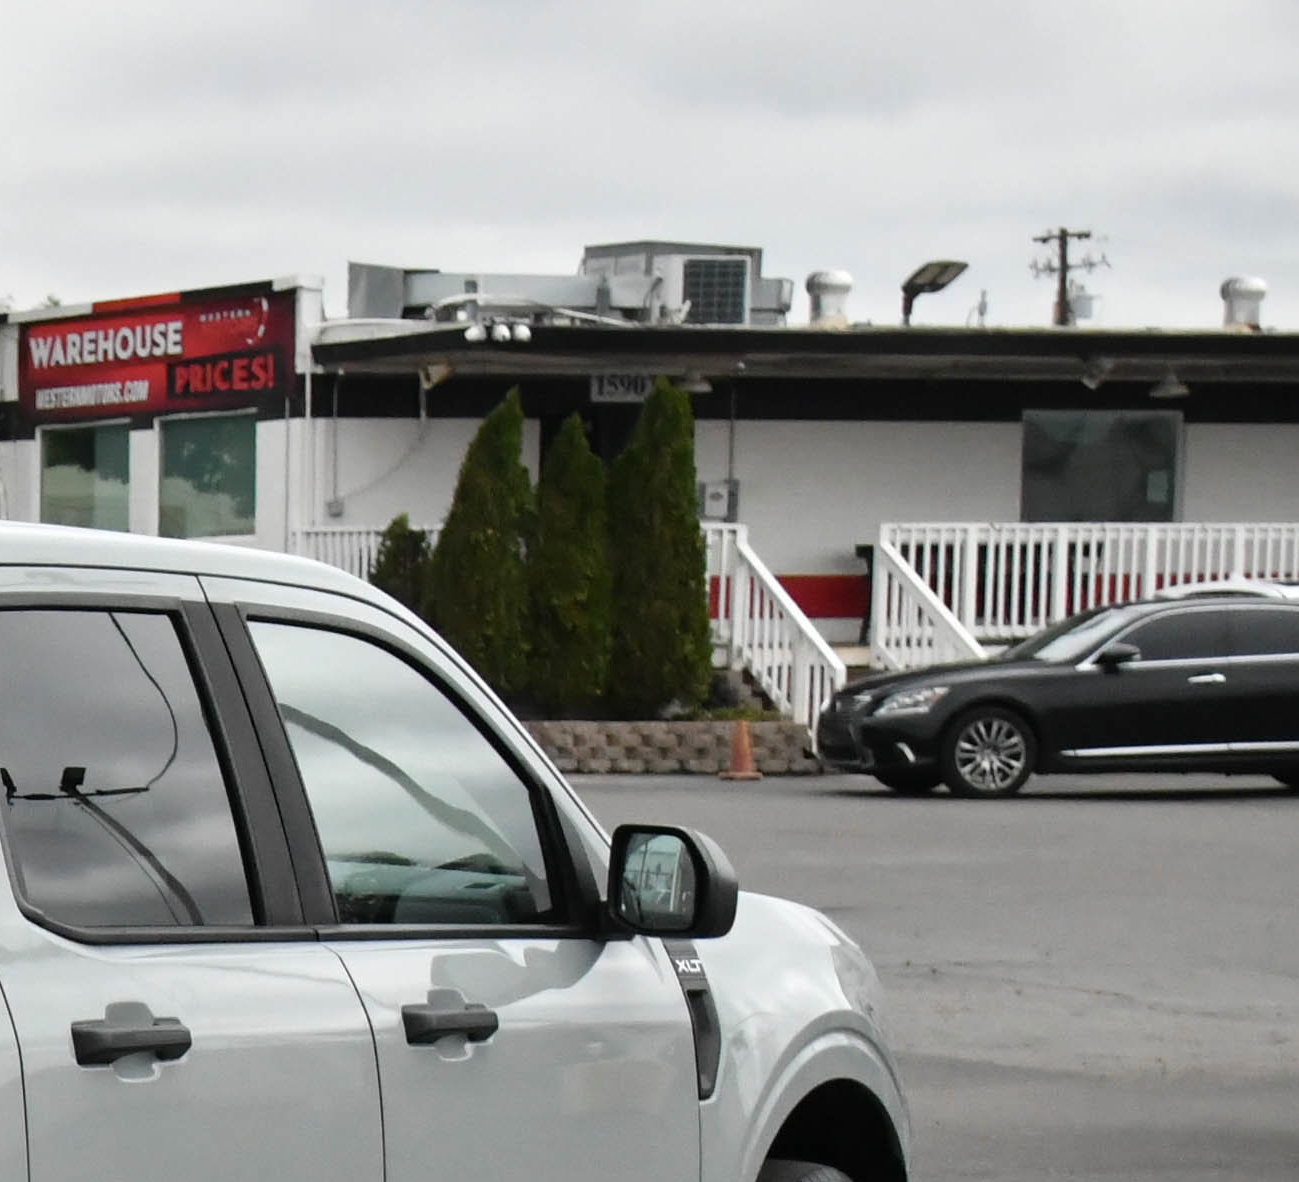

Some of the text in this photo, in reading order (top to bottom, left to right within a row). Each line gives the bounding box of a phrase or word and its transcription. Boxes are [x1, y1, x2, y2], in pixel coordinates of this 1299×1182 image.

[29, 320, 183, 370] WAREHOUSE
[174, 354, 275, 394] PRICES!
[35, 379, 150, 411] WESTERNMOTORS.COM
[675, 959, 702, 973] XLT
